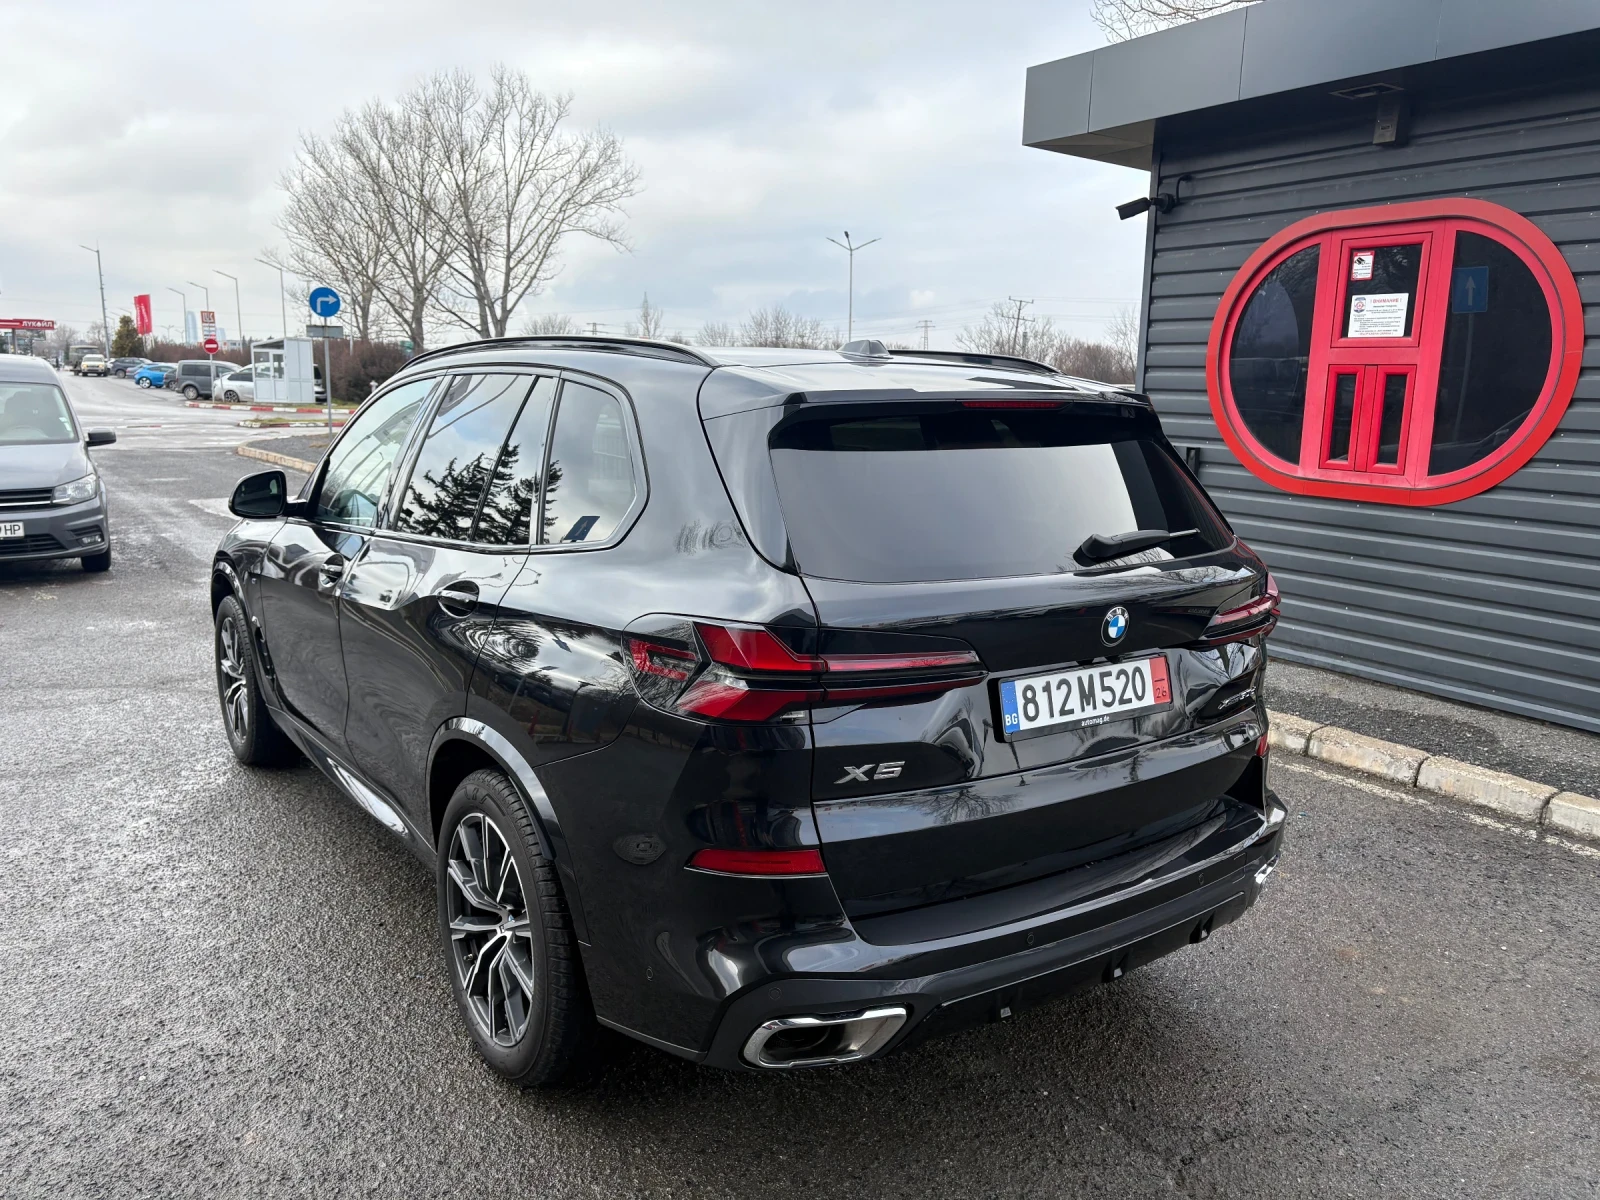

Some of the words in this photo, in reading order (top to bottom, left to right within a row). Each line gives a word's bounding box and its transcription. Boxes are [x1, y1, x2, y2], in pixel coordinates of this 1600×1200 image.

[1155, 686, 1168, 699] 26
[1005, 713, 1018, 726] BG
[1081, 715, 1110, 727] automag.de
[833, 760, 906, 784] X5
